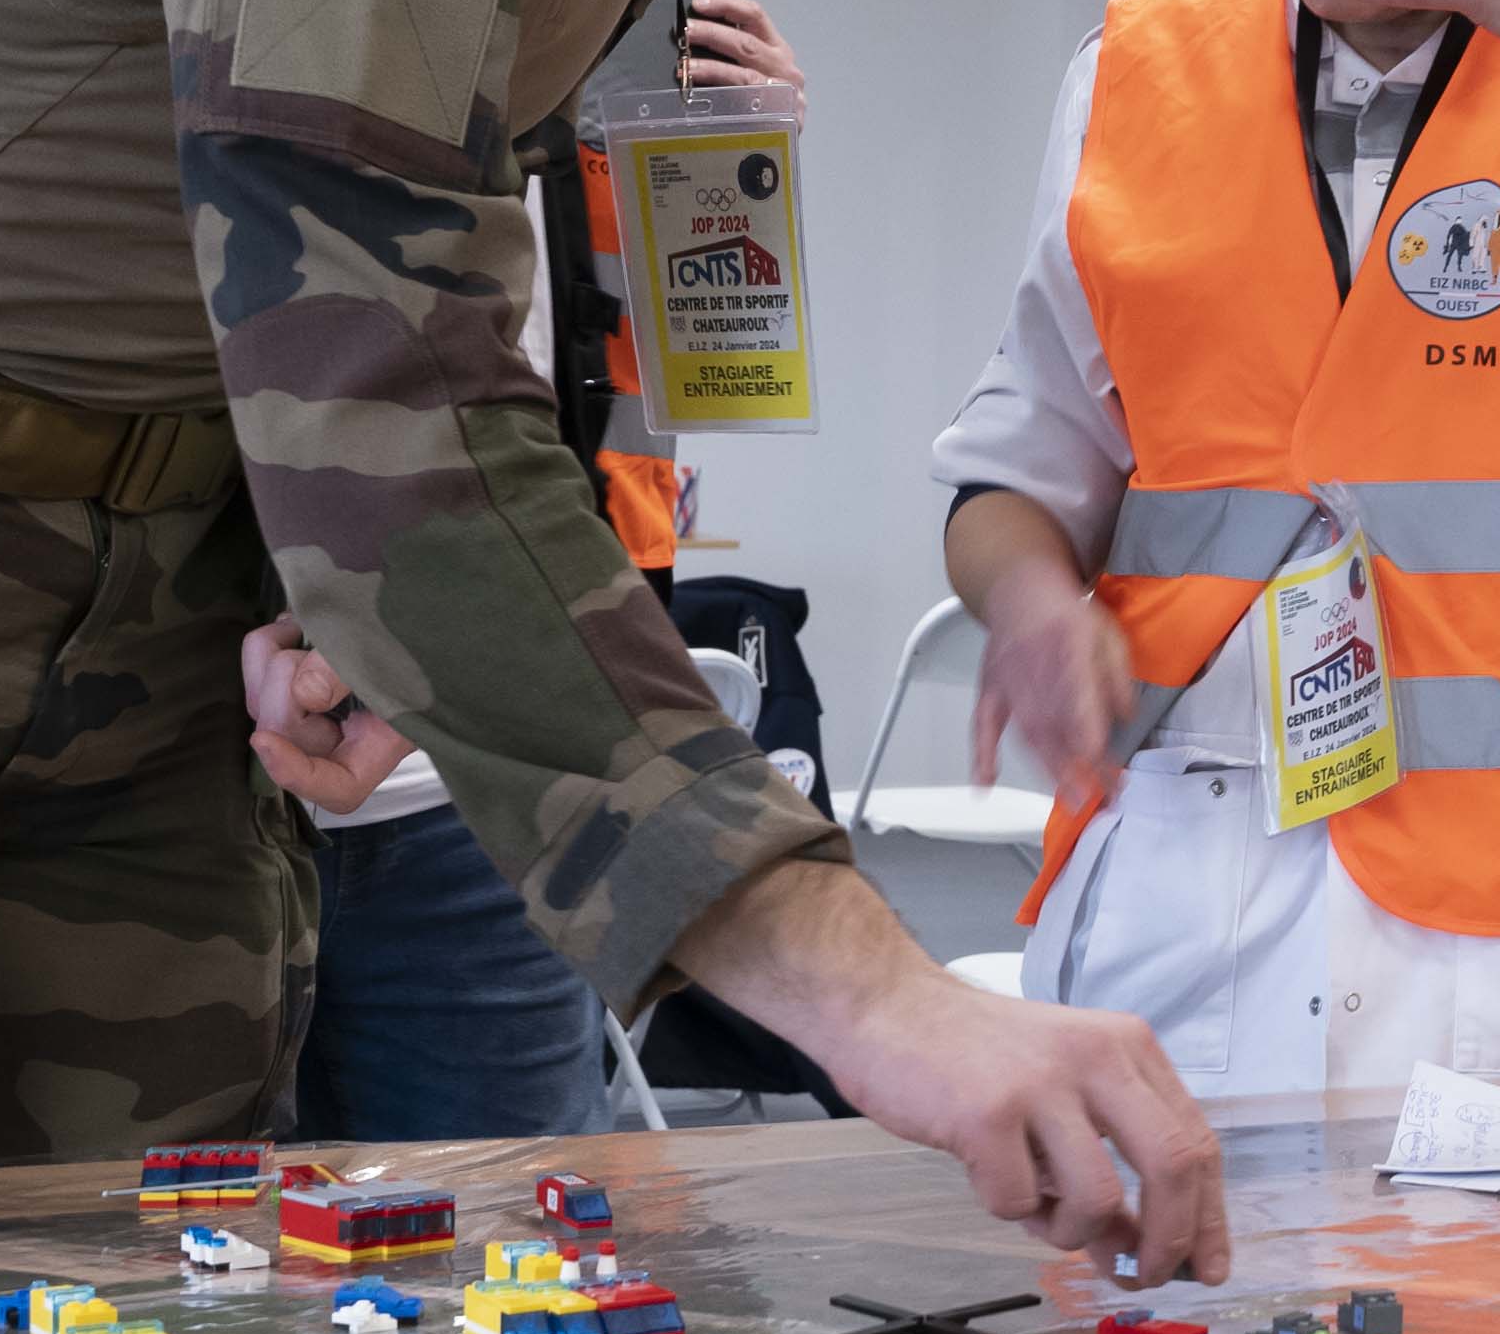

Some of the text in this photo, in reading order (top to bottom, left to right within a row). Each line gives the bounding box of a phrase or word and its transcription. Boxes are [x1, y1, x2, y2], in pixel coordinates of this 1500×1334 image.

[690, 214, 750, 235] JOP 2024
[1430, 277, 1489, 291] EIZ NRBC
[667, 293, 789, 312] CENTRE DE TIR SPORTIF
[1435, 298, 1480, 312] OUEST
[693, 316, 769, 332] CHATEAUROUX
[712, 341, 722, 350] 24
[725, 339, 757, 350] Janvier
[759, 339, 780, 350] 2024
[700, 365, 774, 381] STAGIAIRE
[684, 381, 793, 397] ENTRAINEMENT
[1314, 617, 1357, 652] JOP 2024
[1286, 676, 1381, 728] CENTRE DE TIR SPORTIF
[1309, 705, 1370, 742] CHATEAUROUX
[1325, 743, 1335, 755] 24
[1336, 732, 1361, 750] Janvier
[1361, 723, 1377, 739] 2024
[1311, 748, 1373, 785] STAGIAIRE
[1295, 756, 1386, 805] ENTRAINEMENT
